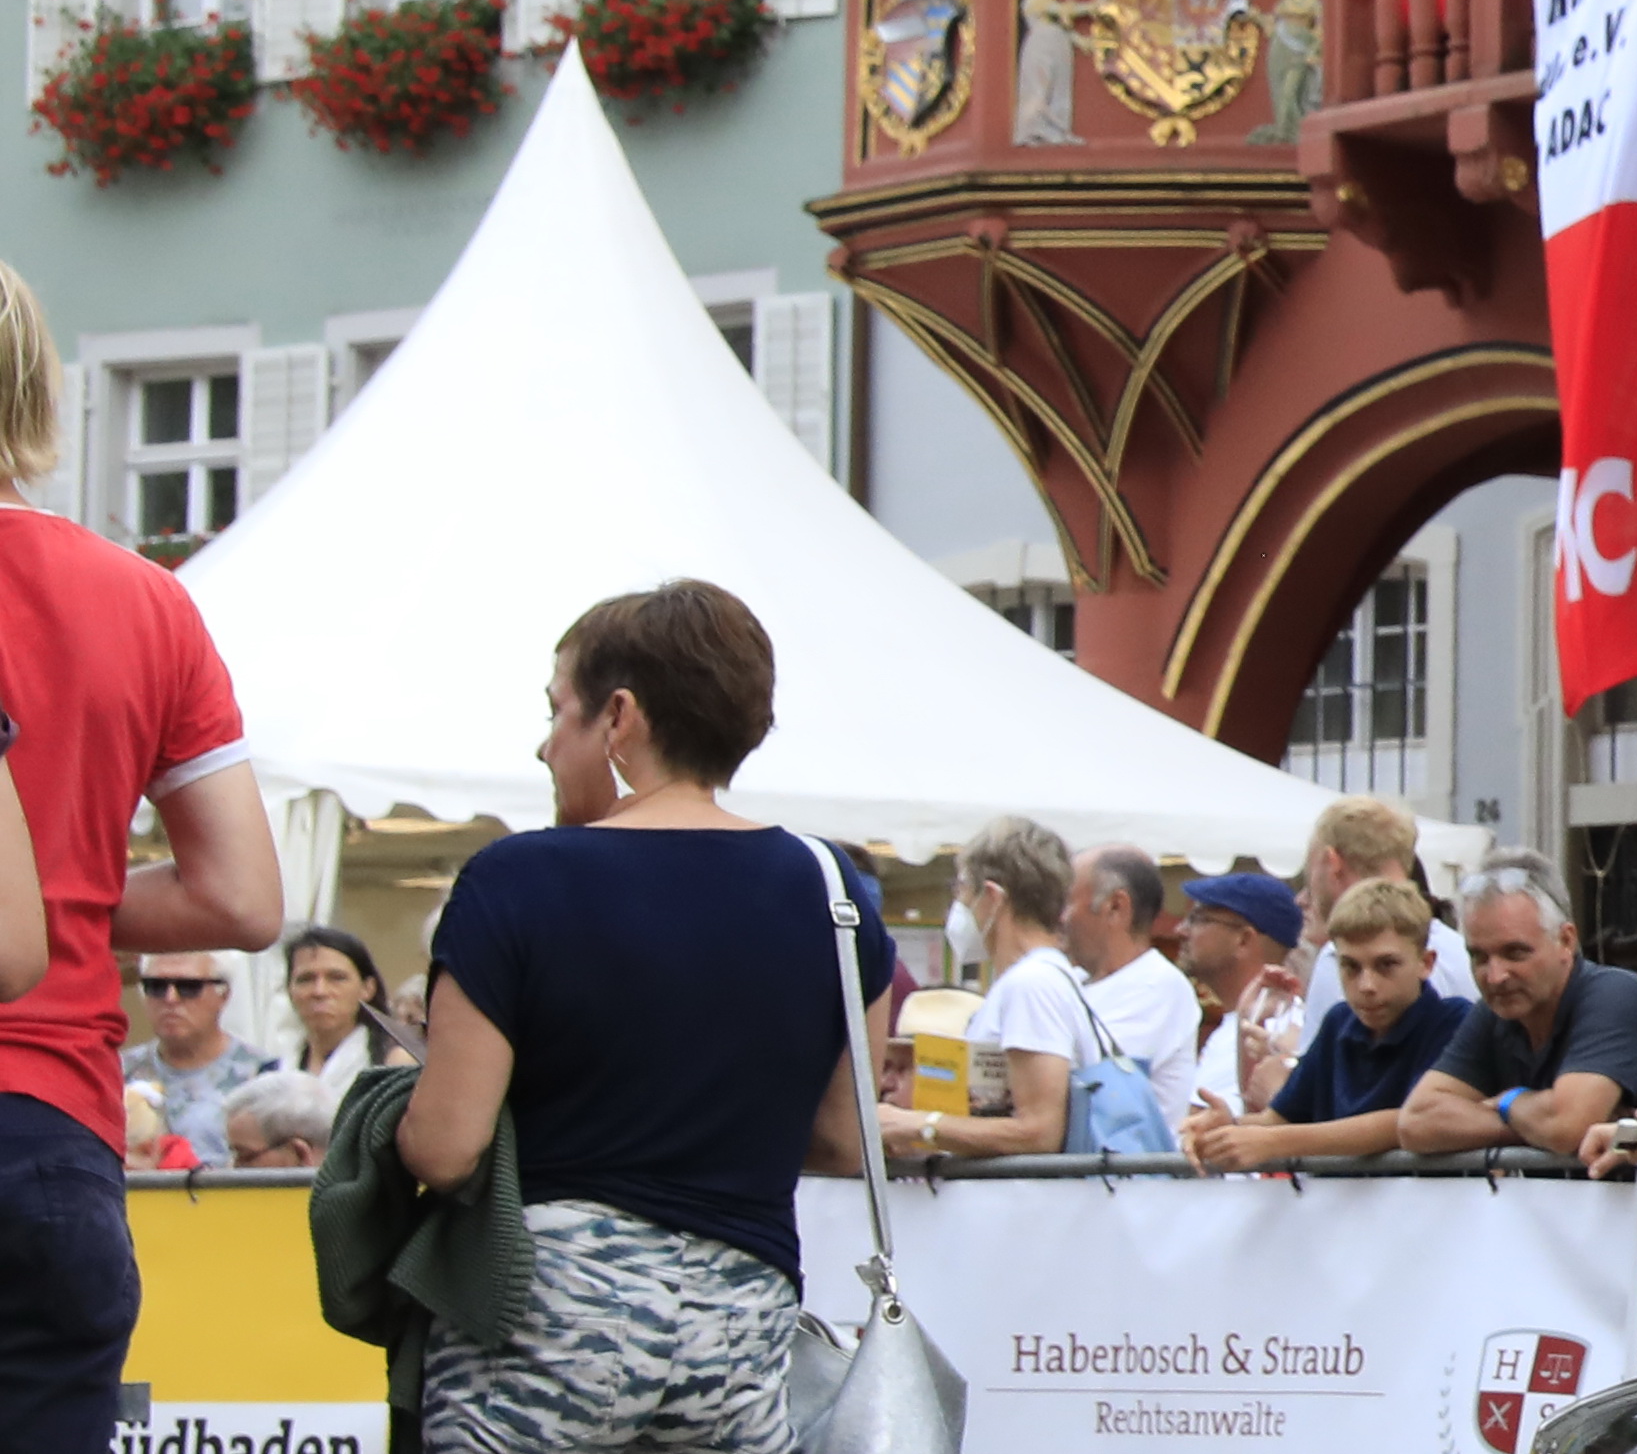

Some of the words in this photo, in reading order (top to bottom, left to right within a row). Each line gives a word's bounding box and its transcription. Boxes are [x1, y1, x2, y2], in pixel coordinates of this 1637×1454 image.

[1011, 1332, 1209, 1376] Haberbosch
[1222, 1333, 1252, 1376] &
[1261, 1333, 1365, 1377] Straub
[1492, 1349, 1523, 1381] H
[1094, 1401, 1286, 1438] Rechtsanwälte
